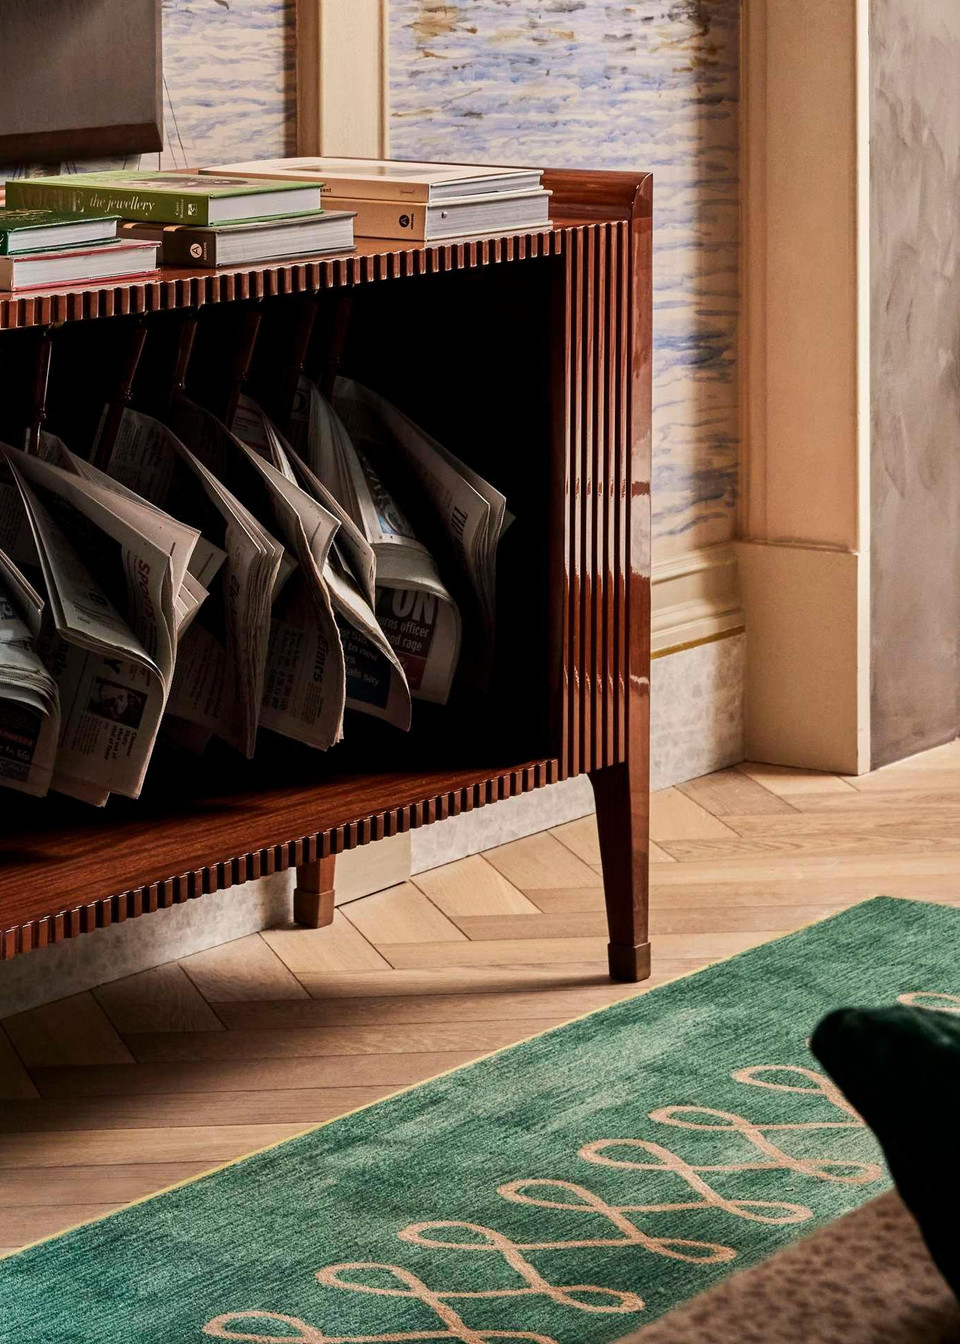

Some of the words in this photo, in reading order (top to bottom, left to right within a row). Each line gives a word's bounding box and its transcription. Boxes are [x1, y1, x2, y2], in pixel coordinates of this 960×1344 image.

[17, 187, 85, 213] VOGUE
[89, 193, 106, 209] the
[105, 196, 156, 216] jewellery
[401, 621, 430, 638] officer
[402, 637, 423, 653] rage
[363, 672, 381, 688] say
